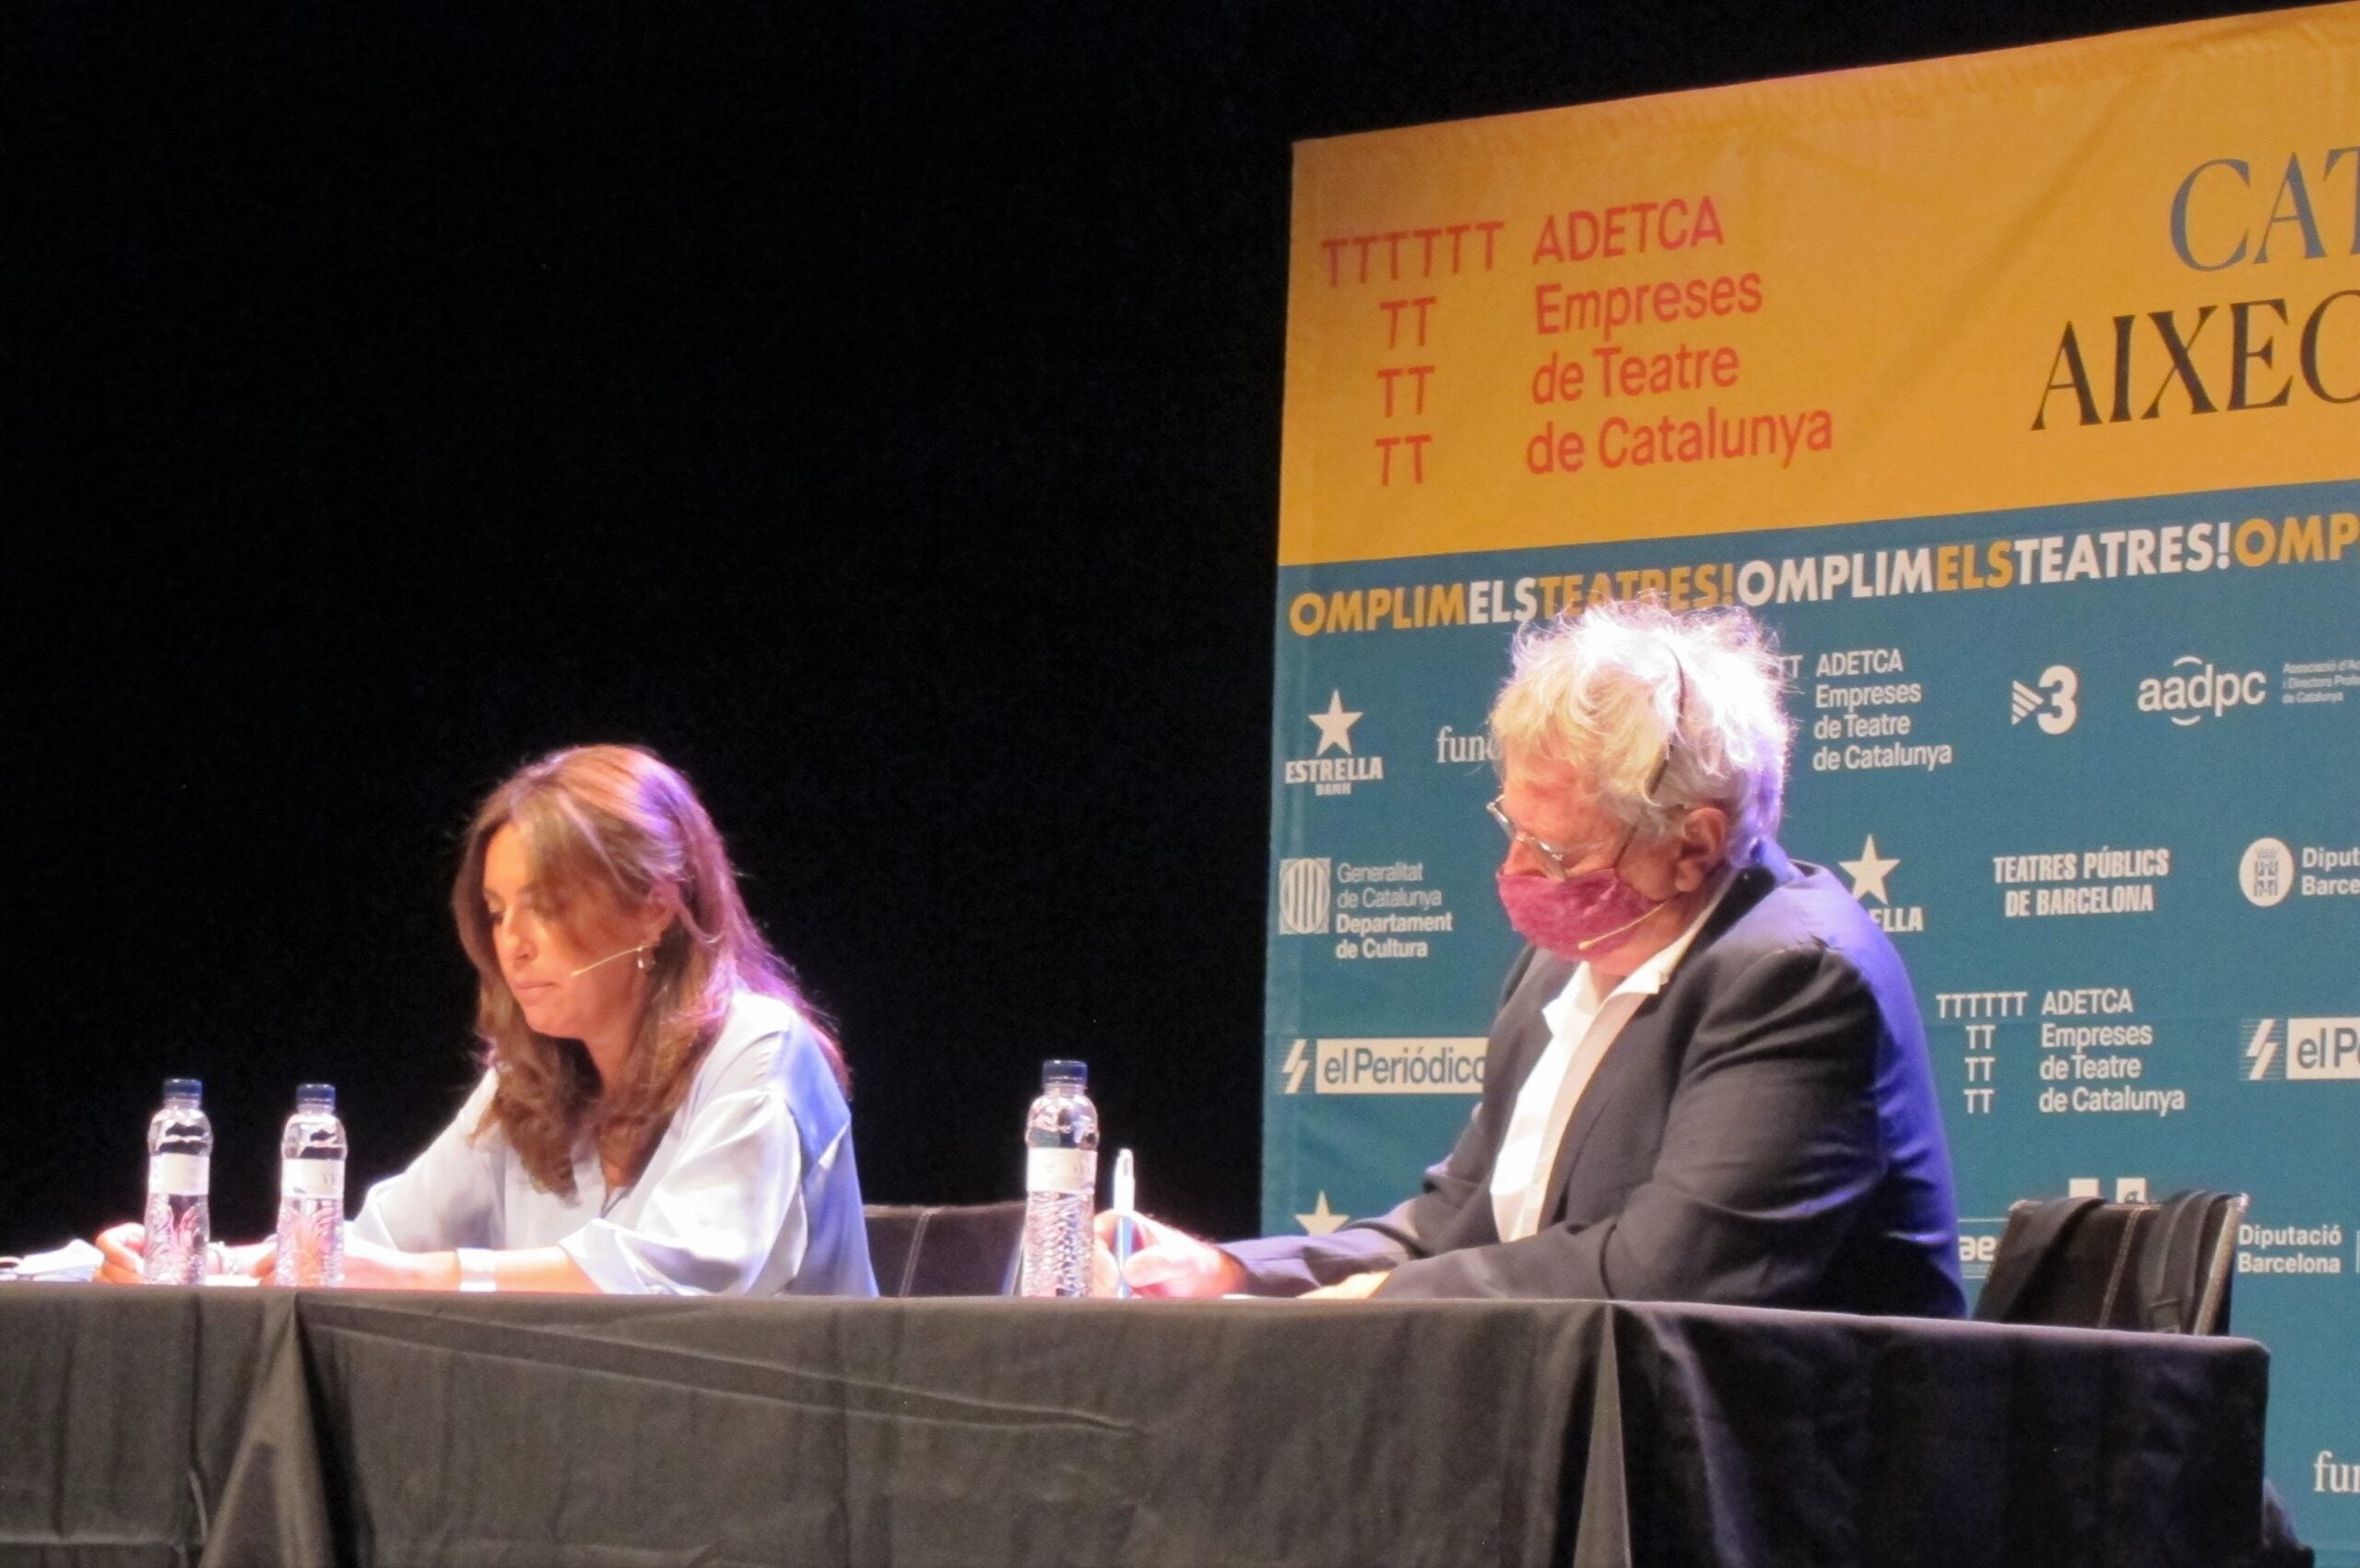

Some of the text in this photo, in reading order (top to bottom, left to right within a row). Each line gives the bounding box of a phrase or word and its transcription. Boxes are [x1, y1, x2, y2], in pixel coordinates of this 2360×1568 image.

[1532, 195, 1724, 265] ADETCA
[1534, 272, 1763, 342] Empreses
[1532, 344, 1740, 404] de Teatre
[1526, 407, 1832, 474] de Catalunya
[1816, 648, 1904, 677] ADETCA
[1815, 683, 1922, 713] Empreses
[2037, 665, 2077, 734] 3
[2138, 664, 2266, 717] aadpc
[1813, 713, 1911, 739] de Teatre
[1285, 757, 1383, 784] ESTRELLA
[1812, 742, 1953, 772] de Catalunya
[1338, 862, 1423, 883] Generalitat
[1992, 845, 2170, 883] TEATRES PÚBLICS
[1337, 887, 1443, 910] de Catalunya
[2005, 884, 2154, 917] DE BARCELONA
[1336, 913, 1454, 937] Departament
[1336, 937, 1428, 959] de Cultura
[2041, 988, 2133, 1015] ADETCA
[2040, 1023, 2154, 1053] Empreses
[2039, 1054, 2142, 1079] de Teatre
[2039, 1085, 2186, 1117] de Catalunya
[2238, 1223, 2342, 1249] Diputació
[2237, 1252, 2341, 1274] Barcelona
